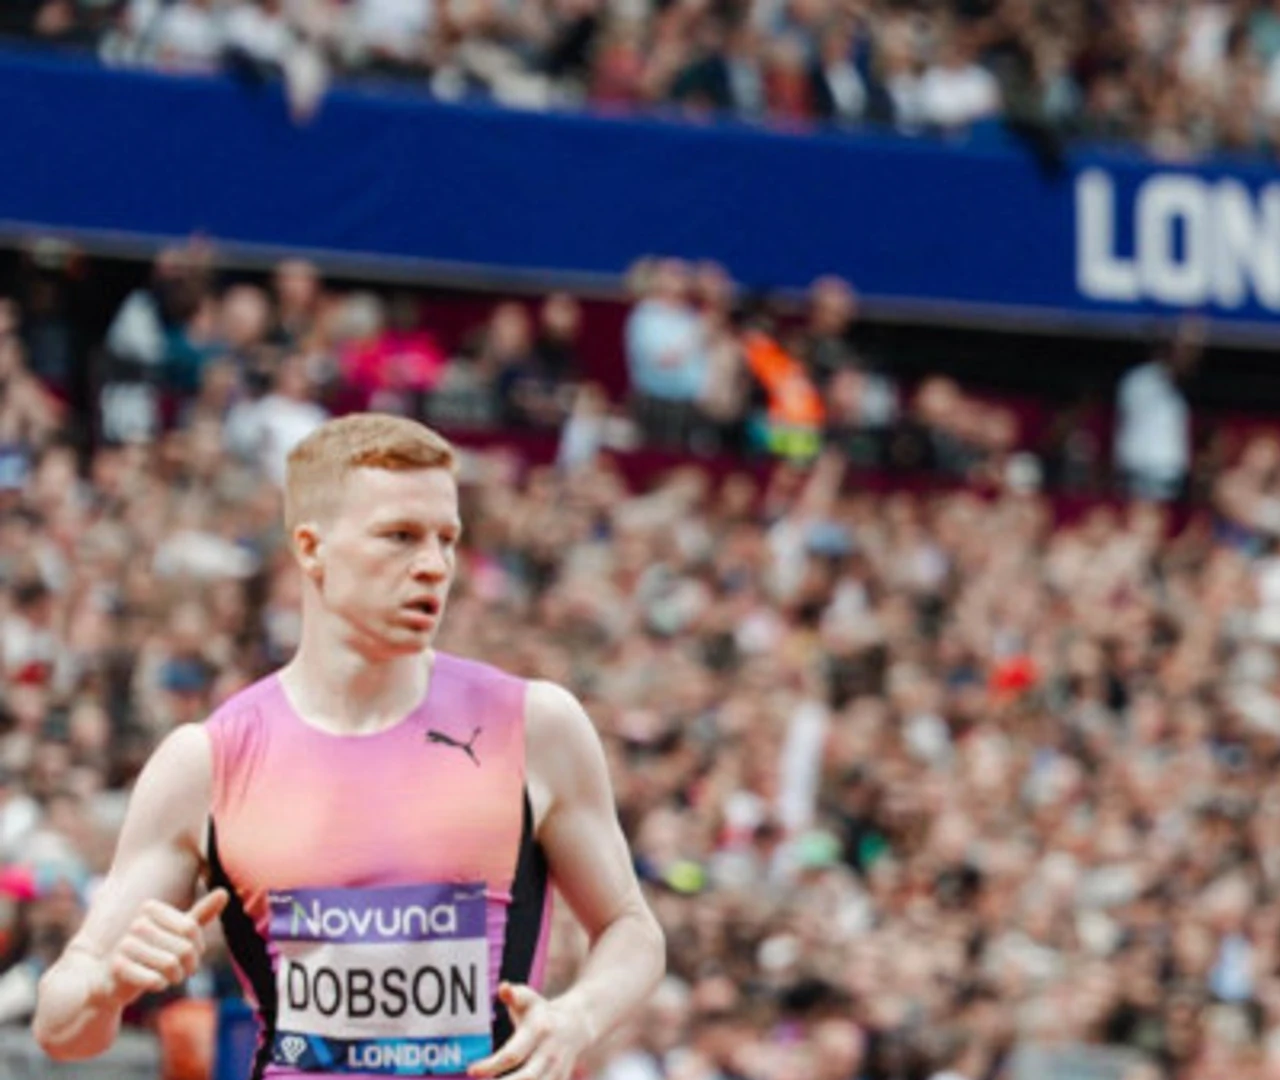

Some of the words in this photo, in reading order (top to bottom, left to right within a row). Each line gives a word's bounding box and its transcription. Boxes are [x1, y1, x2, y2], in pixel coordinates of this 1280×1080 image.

[291, 900, 457, 938] Novuna
[287, 962, 478, 1019] DOBSON
[347, 1042, 462, 1069] LONDON
